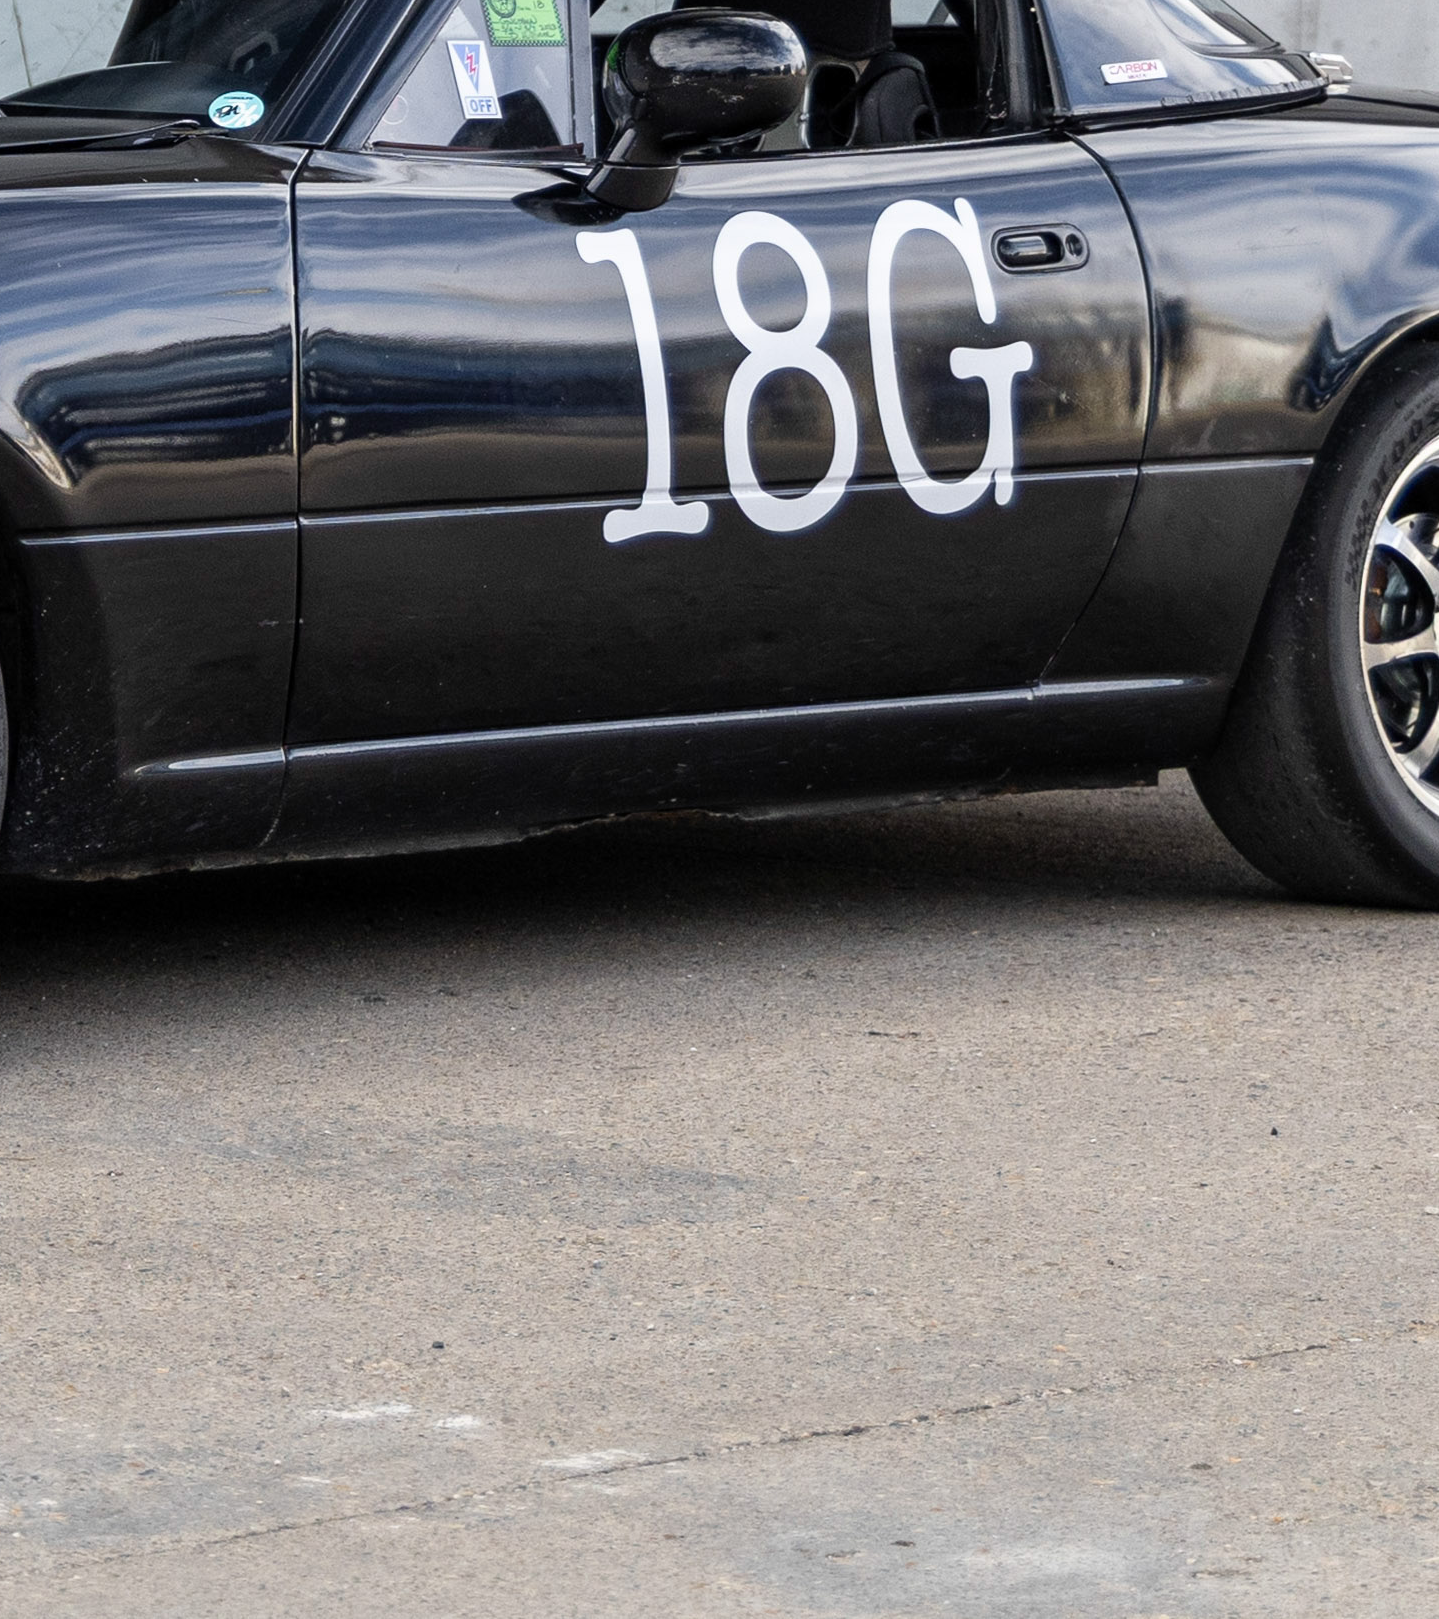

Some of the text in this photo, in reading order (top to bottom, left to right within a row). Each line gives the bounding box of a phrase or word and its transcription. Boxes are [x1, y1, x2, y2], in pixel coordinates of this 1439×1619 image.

[1108, 62, 1158, 75] CARBON
[470, 99, 492, 113] OFF
[575, 197, 1034, 543] 18G
